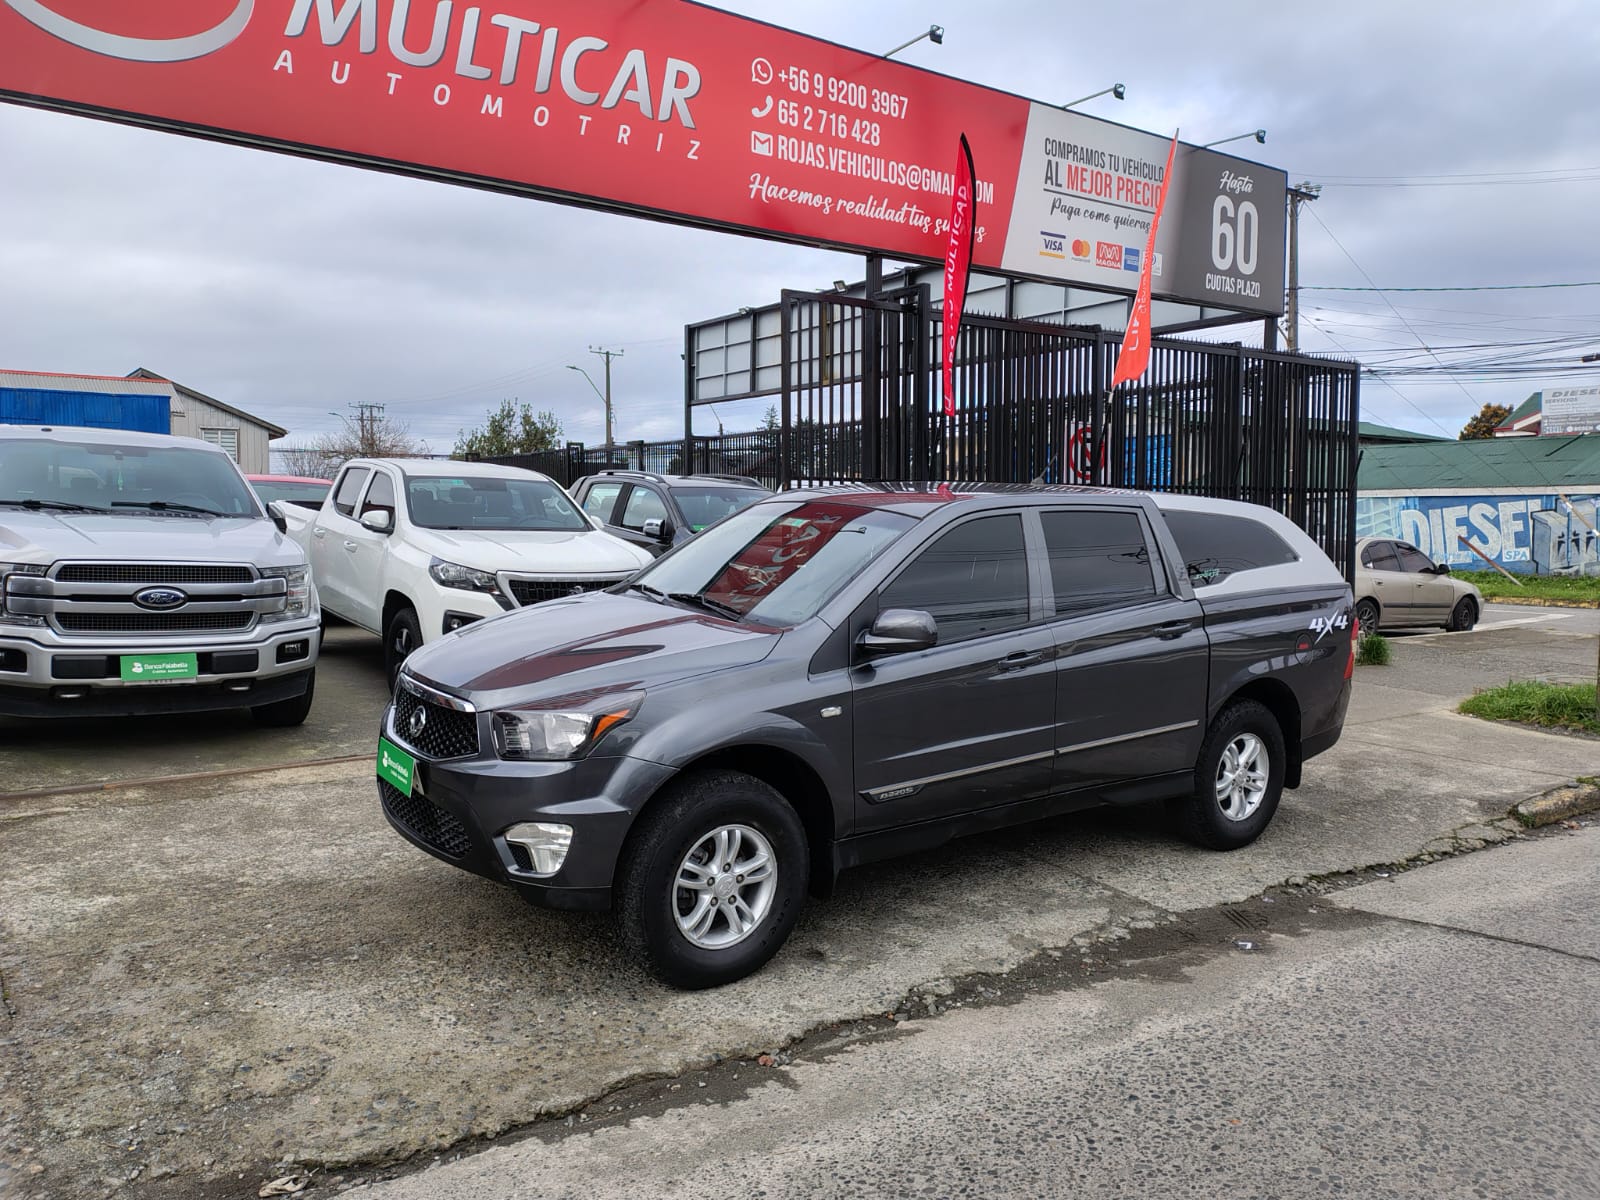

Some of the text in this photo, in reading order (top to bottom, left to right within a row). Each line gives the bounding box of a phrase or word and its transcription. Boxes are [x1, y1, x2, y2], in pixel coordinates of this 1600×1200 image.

[283, 0, 702, 130] MULTICAR
[273, 49, 701, 161] AUTOMOTRIZ
[778, 65, 909, 120] +56 9 9200 3967
[777, 99, 881, 147] 65 2 716 428
[1044, 159, 1162, 209] AL MEJOR PRECIO
[1045, 137, 1164, 183] COMPRAMOS TU VEHÍCULO
[1219, 170, 1254, 194] Hasta
[748, 172, 834, 215] Hacemos
[836, 194, 905, 223] realidad
[902, 202, 933, 234] tus
[1050, 196, 1082, 217] Paga
[1084, 207, 1111, 223] como
[1043, 238, 1063, 252] VISA
[1212, 194, 1259, 276] 60
[1096, 258, 1121, 268] MAGNA
[1205, 273, 1261, 299] CUOTAS PLAZO
